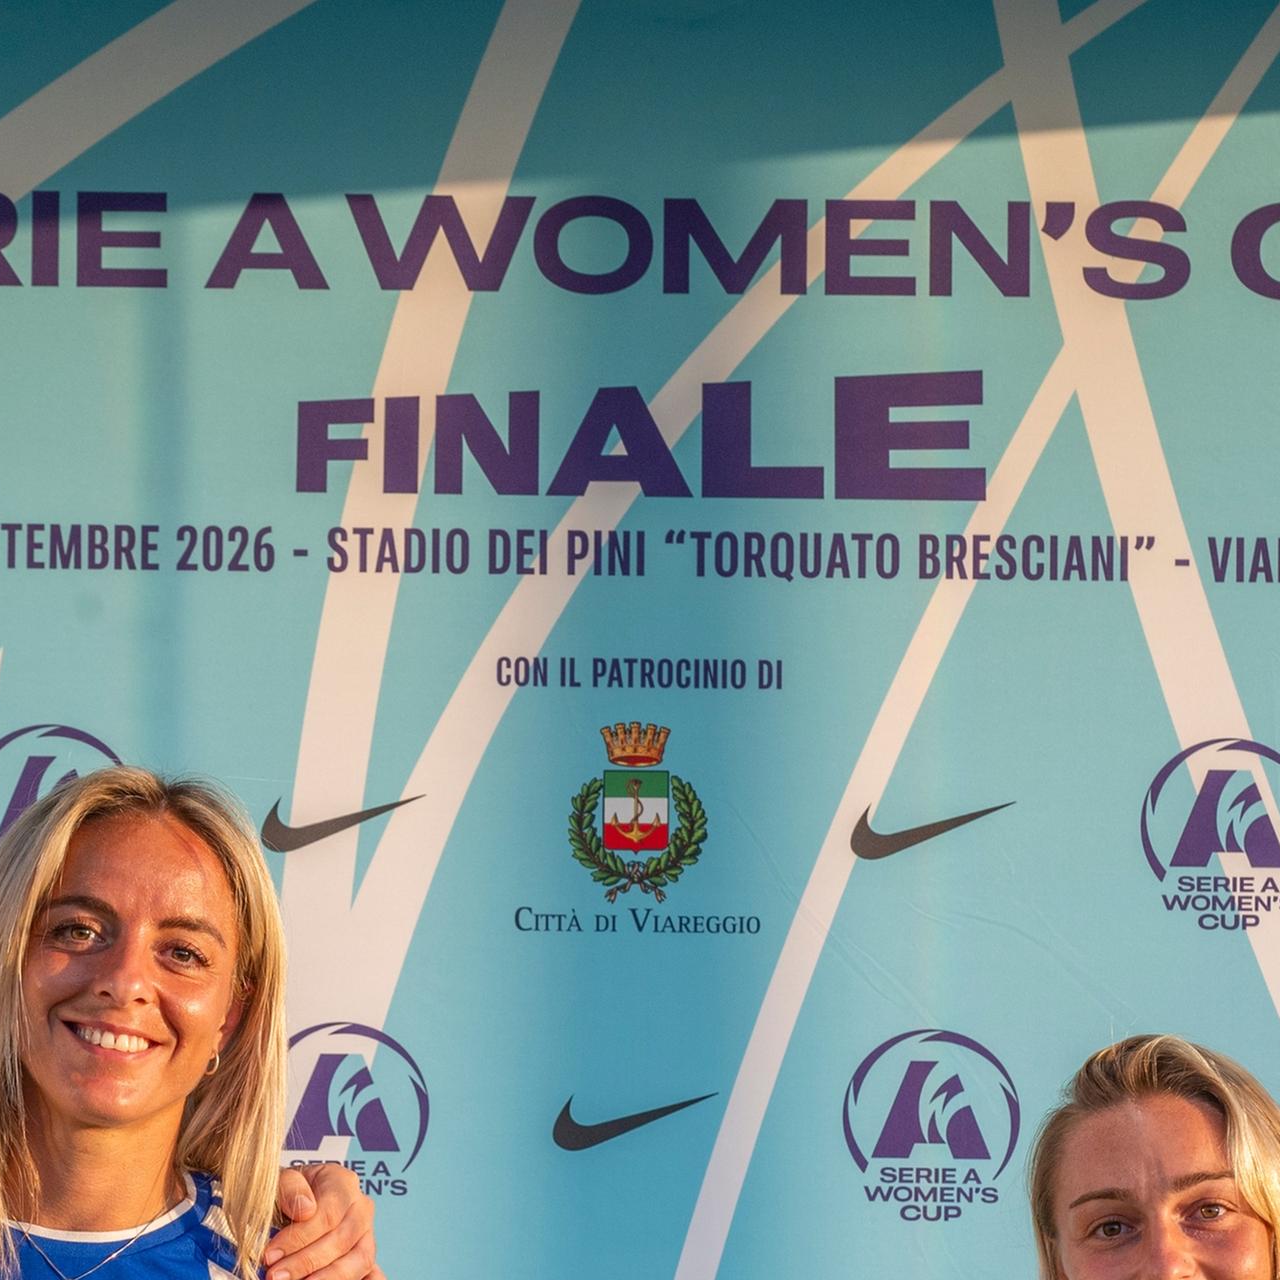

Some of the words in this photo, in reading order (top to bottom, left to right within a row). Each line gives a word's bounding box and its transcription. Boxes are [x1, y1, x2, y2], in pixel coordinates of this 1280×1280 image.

[204, 192, 332, 290] A
[344, 192, 1191, 301] WOMEN'S
[296, 369, 987, 502] FINALE
[175, 524, 275, 573] 2026
[326, 526, 470, 575] STADIO
[488, 528, 548, 576] DEI
[567, 529, 646, 577] PINI
[496, 656, 549, 688] CON
[560, 657, 582, 688] IL
[592, 657, 747, 690] PATROCINIO
[758, 659, 783, 690] DI
[1177, 875, 1255, 893] SERIE
[1260, 876, 1280, 893] A
[1197, 913, 1261, 931] CUP
[371, 1160, 391, 1177] A
[879, 1167, 957, 1185] SERIE
[962, 1168, 982, 1185] A
[863, 1186, 999, 1204] WOMEN'S
[899, 1204, 962, 1222] CUP
